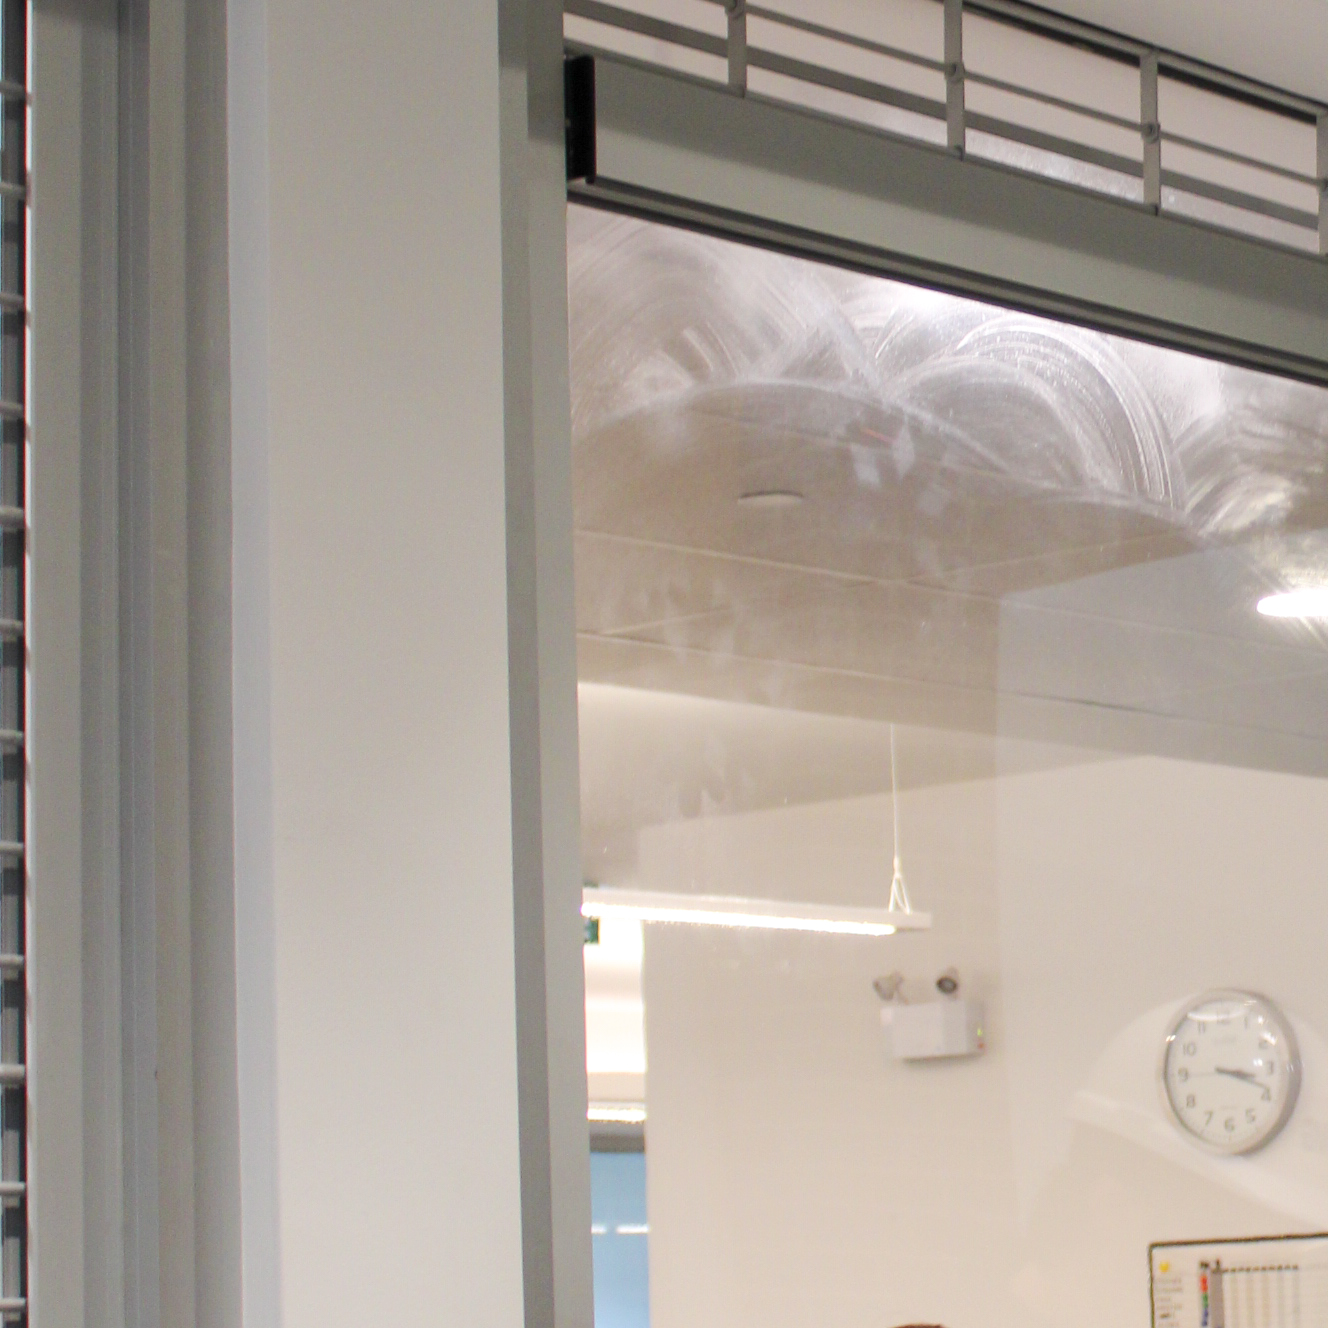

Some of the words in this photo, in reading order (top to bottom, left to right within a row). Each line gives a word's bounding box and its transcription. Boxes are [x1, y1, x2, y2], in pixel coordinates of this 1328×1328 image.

[1182, 1041, 1197, 1056] 10
[1178, 1067, 1189, 1082] 9
[1186, 1093, 1196, 1108] 8
[1260, 1086, 1272, 1102] 4
[1203, 1110, 1214, 1126] 7
[1245, 1108, 1256, 1123] 5
[1224, 1116, 1235, 1132] 6
